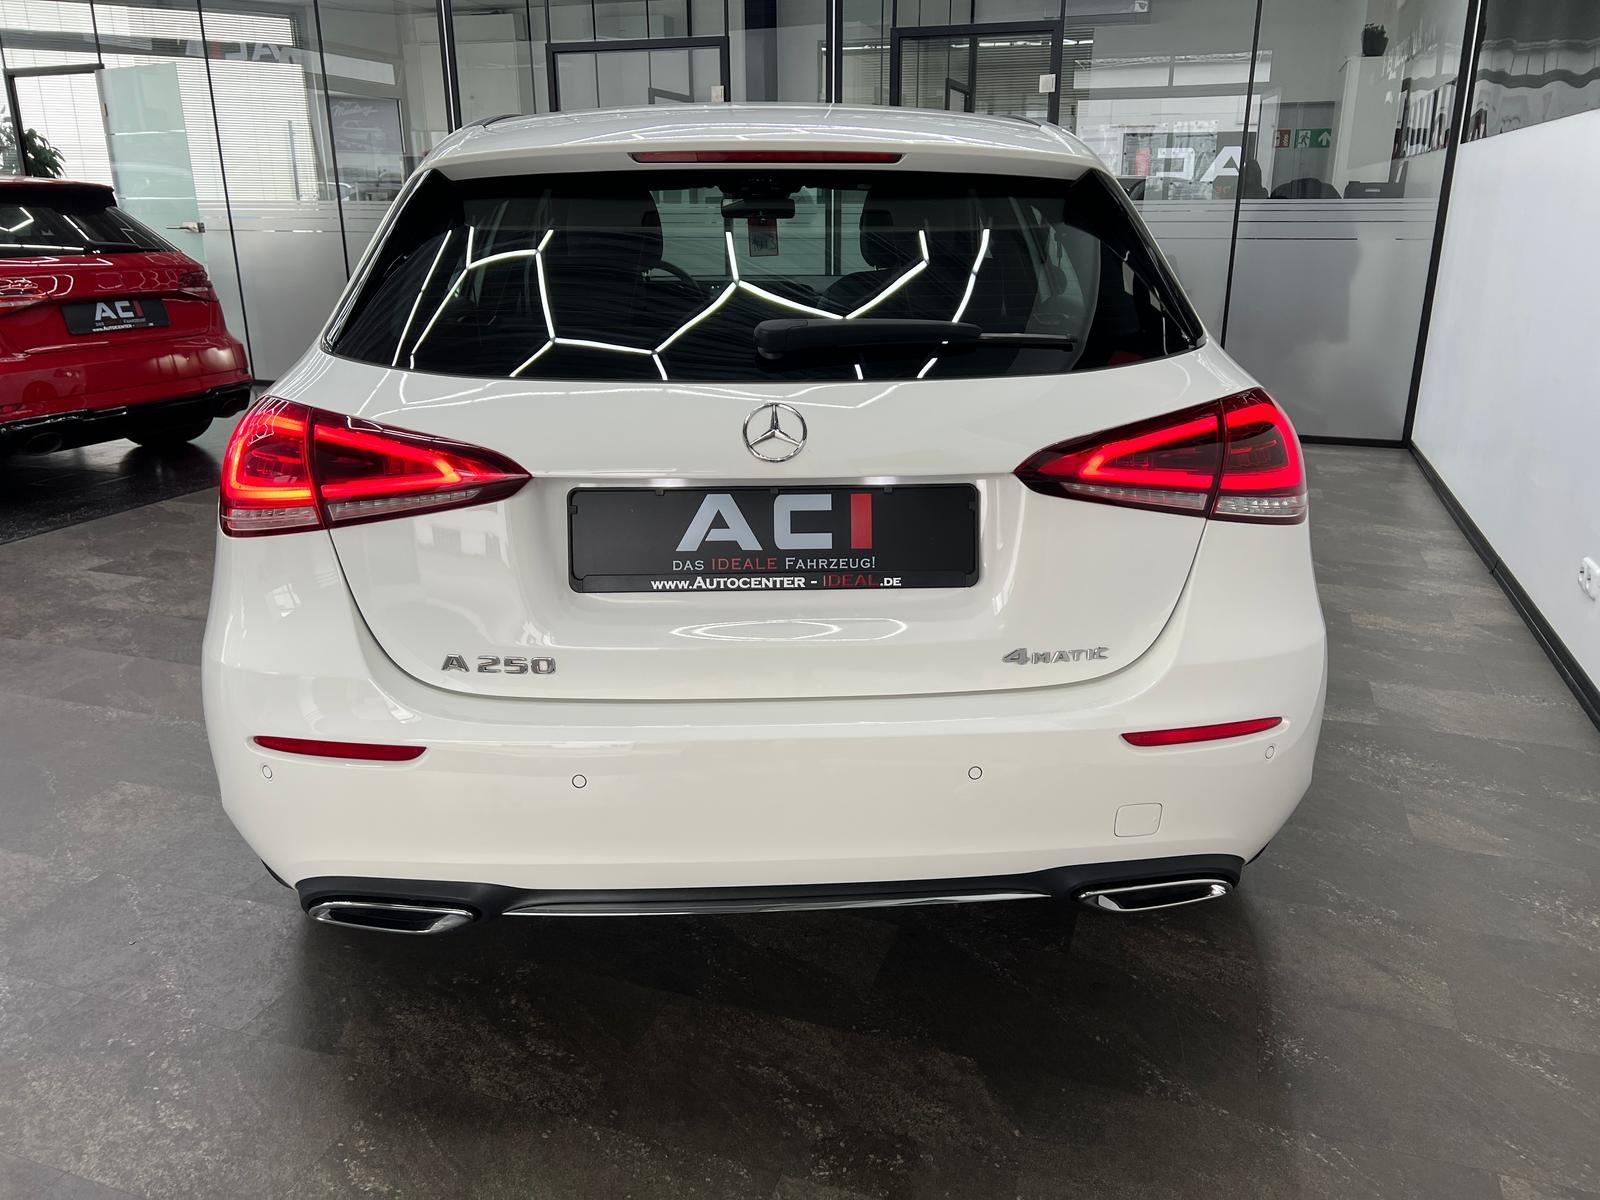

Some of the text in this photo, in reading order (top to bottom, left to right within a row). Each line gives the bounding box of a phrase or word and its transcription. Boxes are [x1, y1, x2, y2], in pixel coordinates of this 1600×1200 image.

[95, 301, 144, 321] ACI
[675, 493, 872, 552] ACI
[672, 556, 876, 571] DAS IDEALE FAHRZEUG!
[441, 653, 556, 675] A 250
[1002, 646, 1110, 665] 4MATIC
